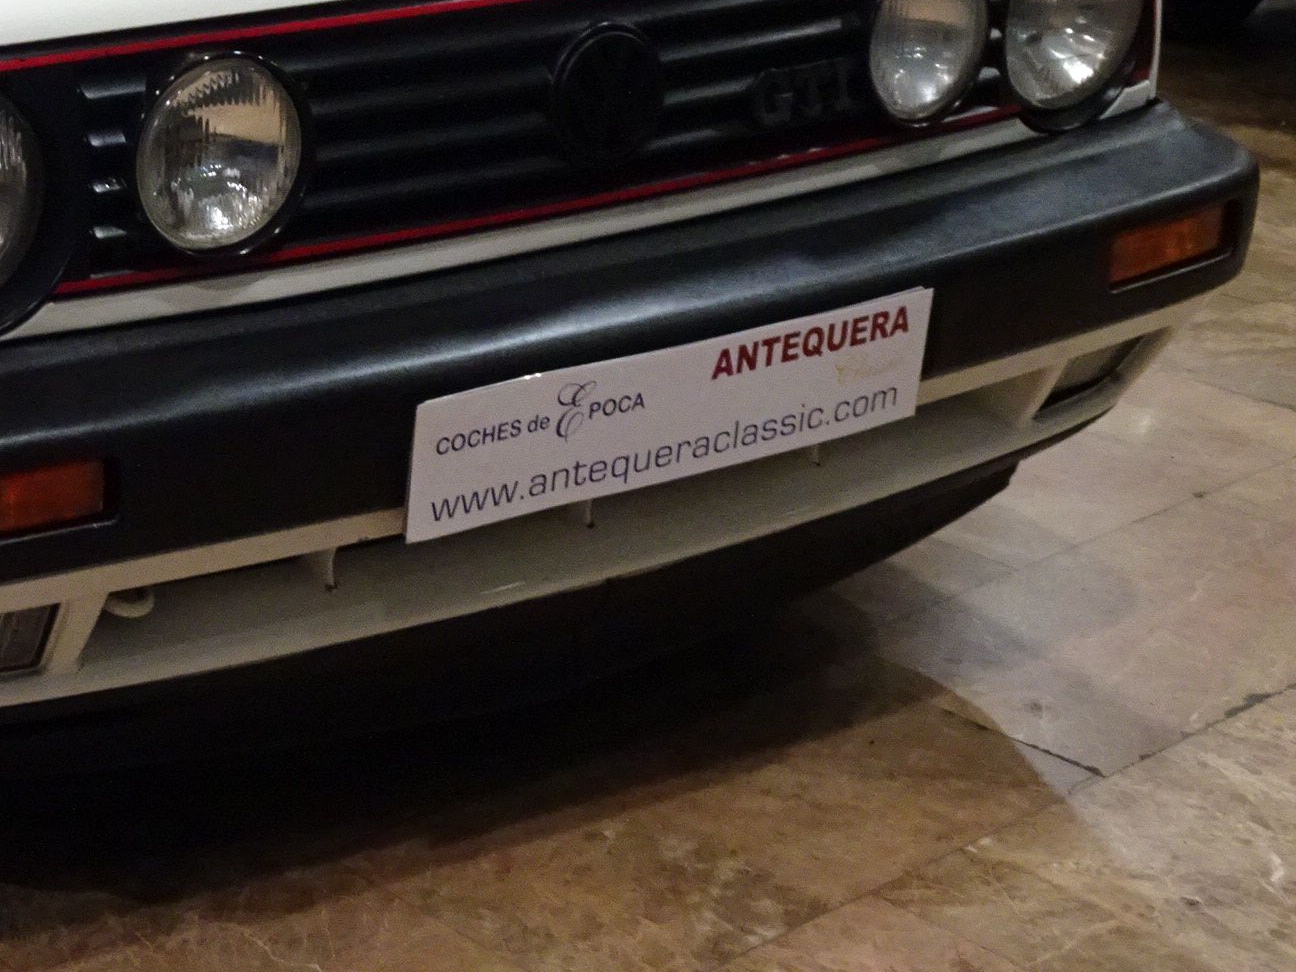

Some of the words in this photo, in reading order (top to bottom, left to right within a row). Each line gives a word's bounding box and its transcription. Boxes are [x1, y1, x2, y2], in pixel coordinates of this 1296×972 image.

[711, 305, 910, 380] ANTEQUERA
[431, 386, 898, 522] www.antequeraclassic.com
[436, 419, 522, 456] COCHES
[527, 415, 550, 433] de
